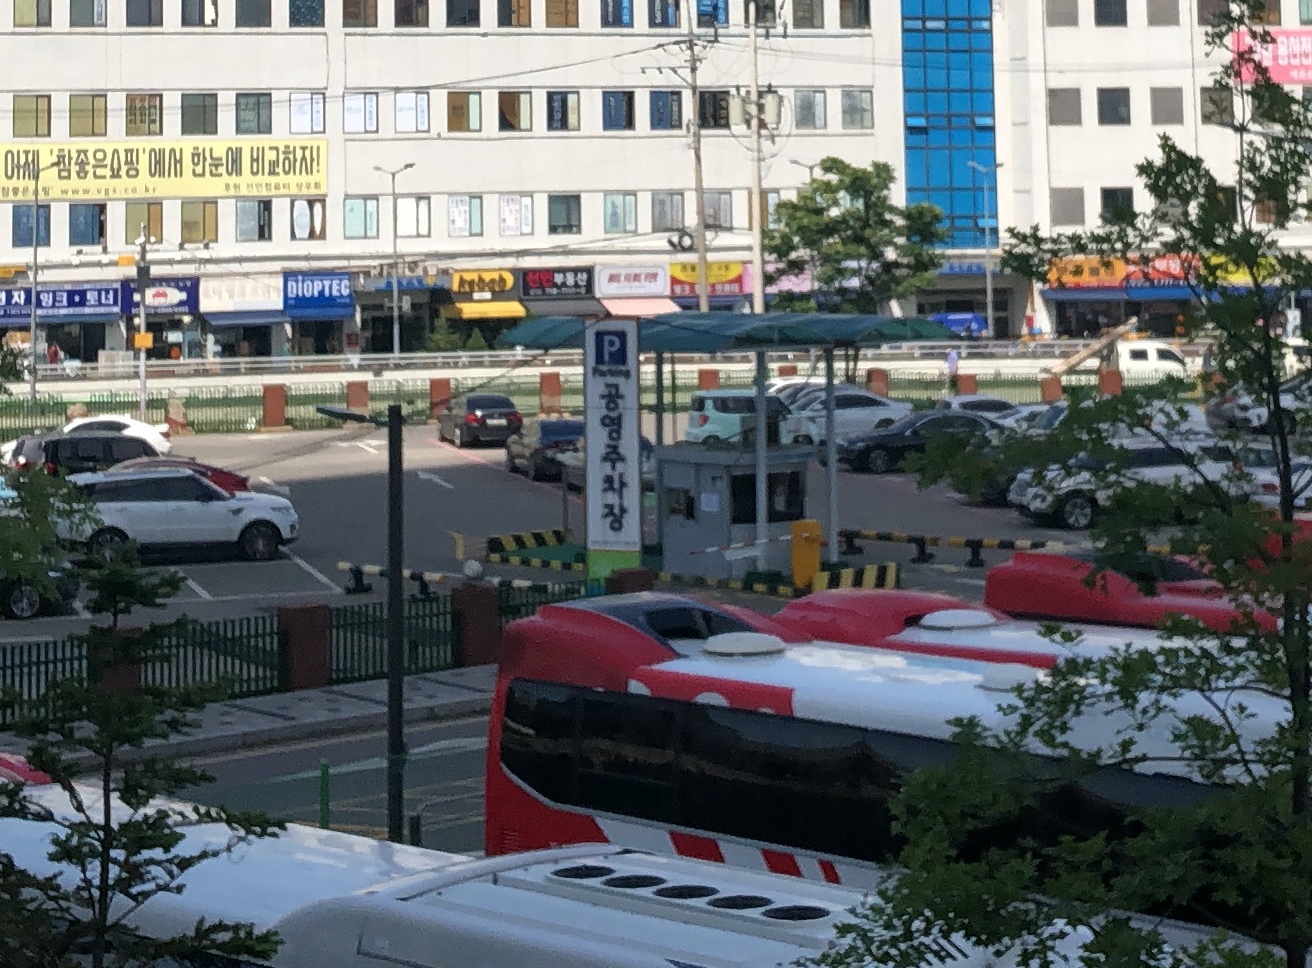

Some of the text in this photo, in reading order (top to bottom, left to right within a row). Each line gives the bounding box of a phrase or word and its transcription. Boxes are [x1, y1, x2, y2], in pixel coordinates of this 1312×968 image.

[191, 146, 243, 177] 한눈에
[249, 144, 321, 177] 비교하자!
[602, 334, 621, 362] P
[599, 383, 629, 532] 공영주차장
